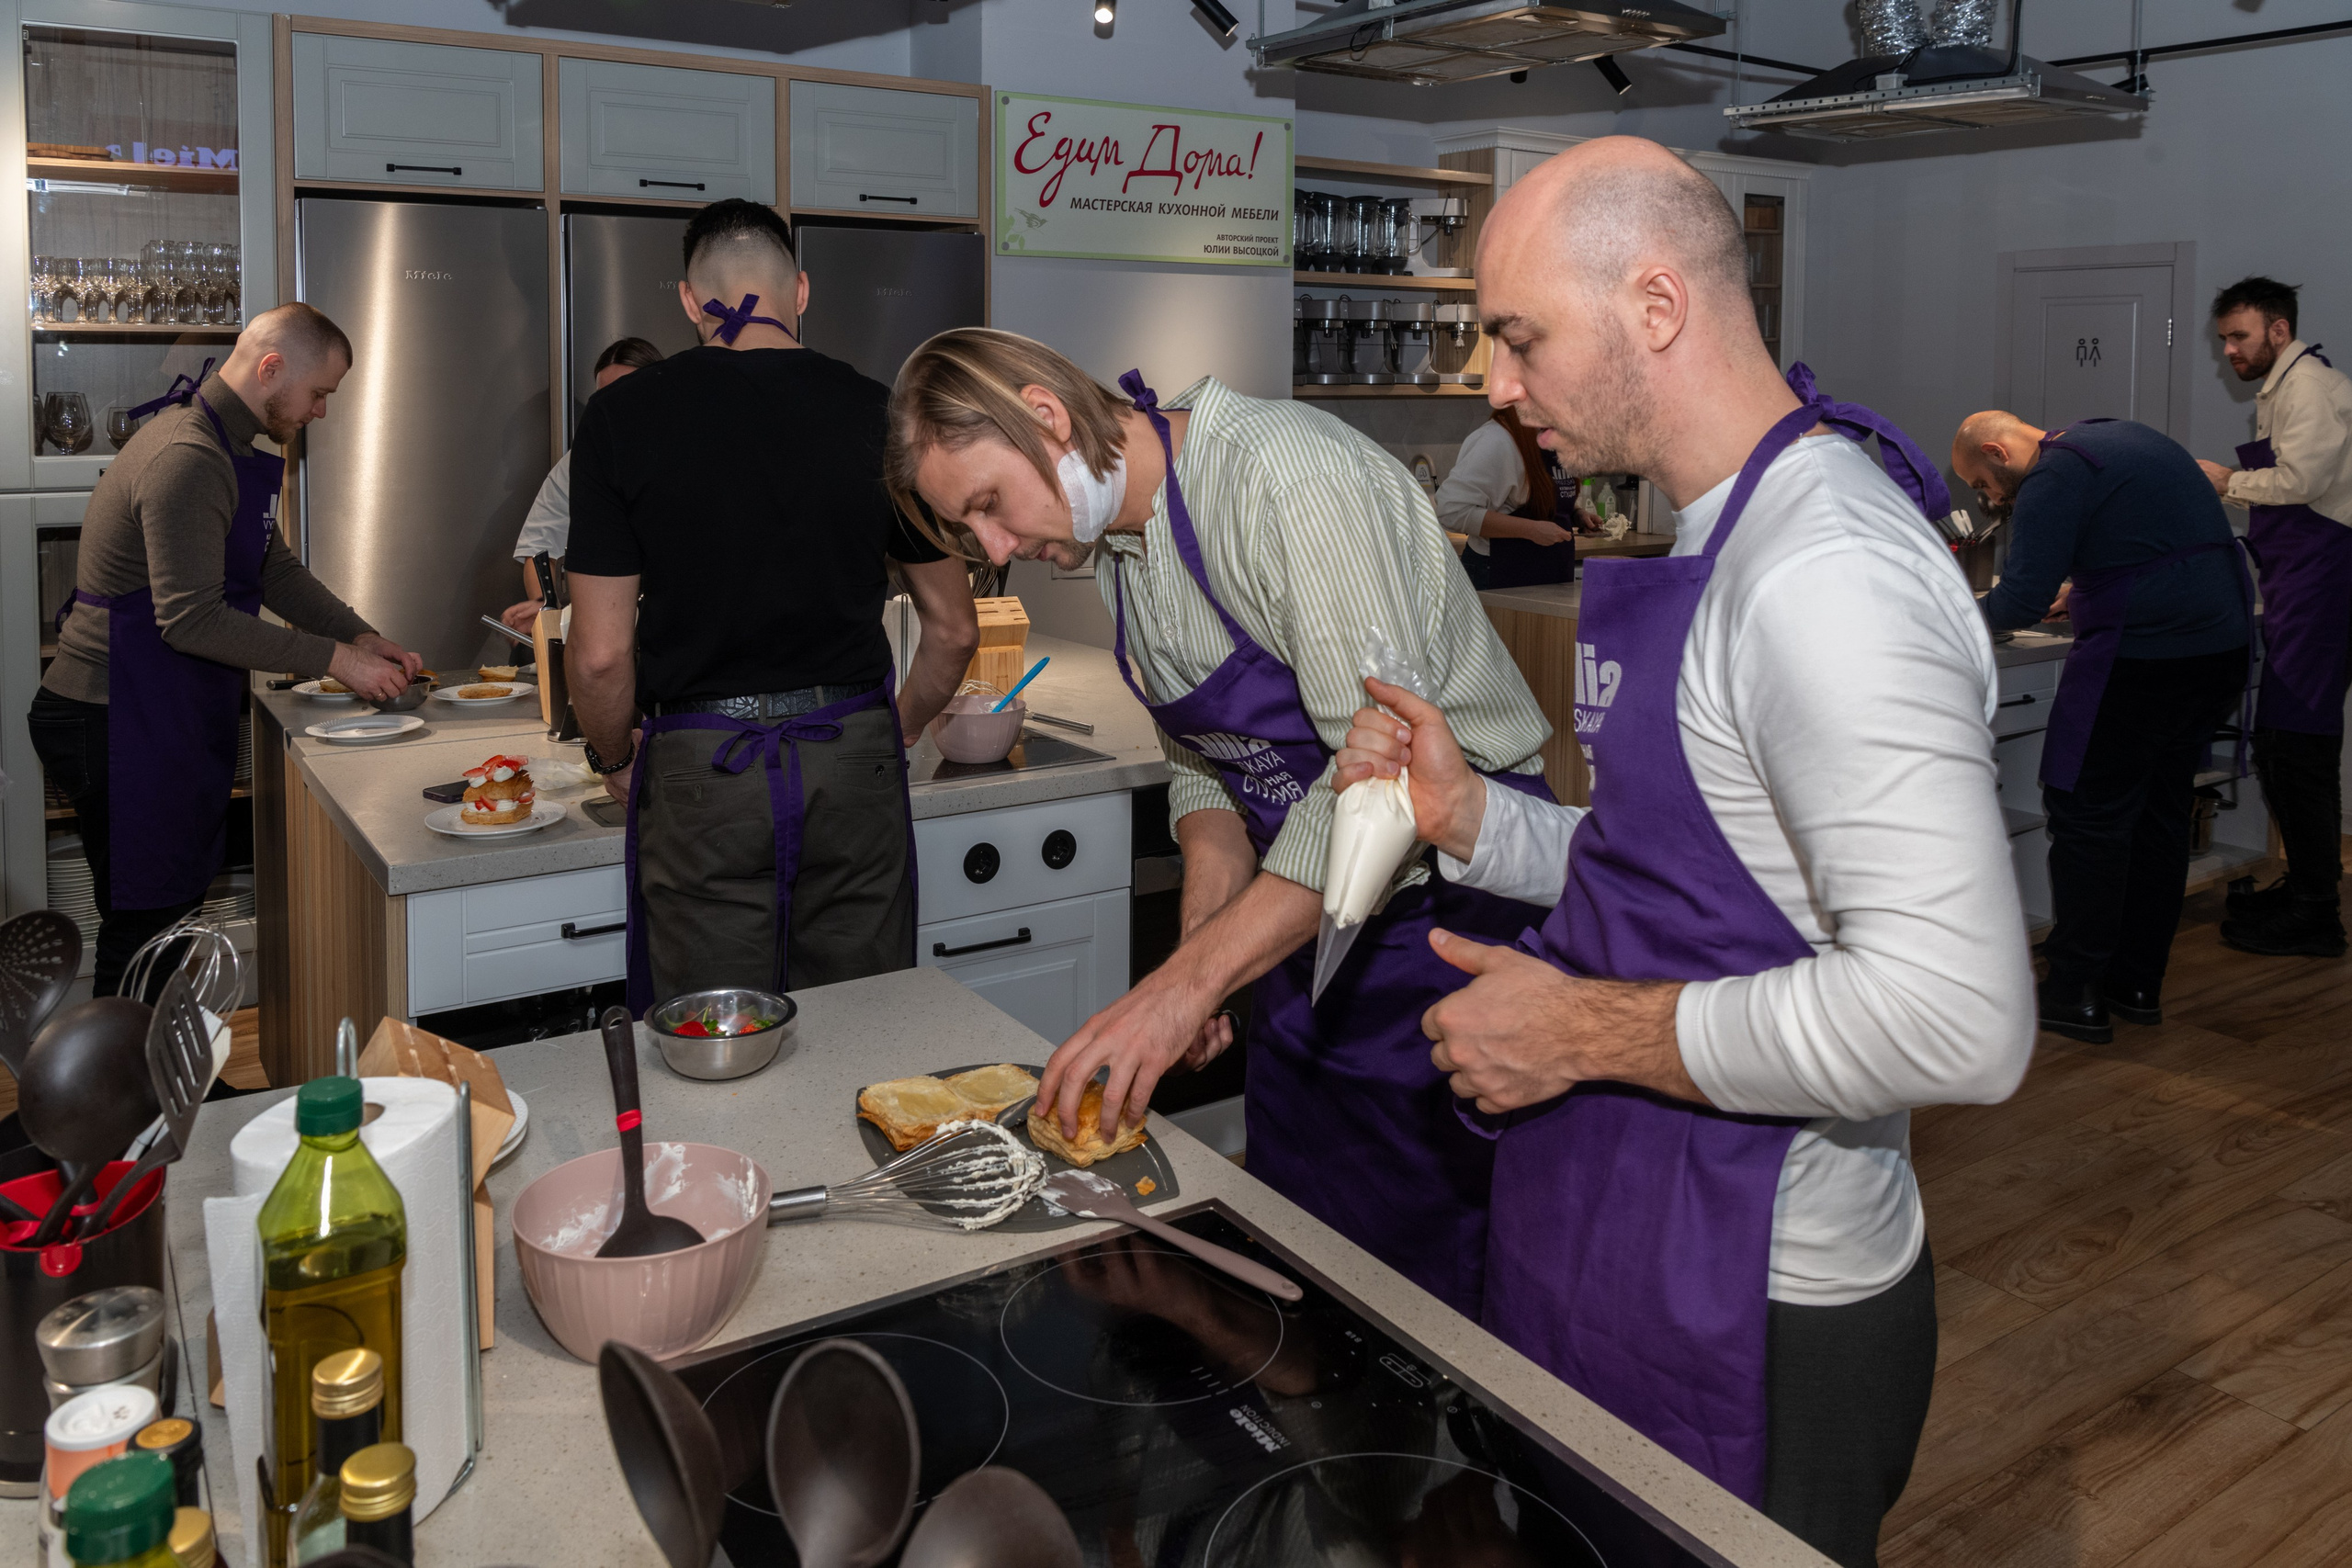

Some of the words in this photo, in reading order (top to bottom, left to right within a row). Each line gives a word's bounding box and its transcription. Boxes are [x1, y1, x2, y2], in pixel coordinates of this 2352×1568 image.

[1013, 111, 1125, 208] Едим
[1122, 124, 1263, 197] Дома!
[1069, 197, 1153, 213] МАСТЕРСКАЯ
[1158, 202, 1226, 218] КУХОННОЙ
[1231, 208, 1279, 221] МЕБЕЛИ
[1204, 244, 1231, 254] ЮЛИИ
[1233, 245, 1279, 256] ВЫСОЦКОЙ
[1216, 233, 1253, 243] АВТОРСКИЙ
[405, 270, 453, 280] Miele
[1229, 1408, 1282, 1453] Miele
[1239, 1404, 1292, 1448] INDUCTION
